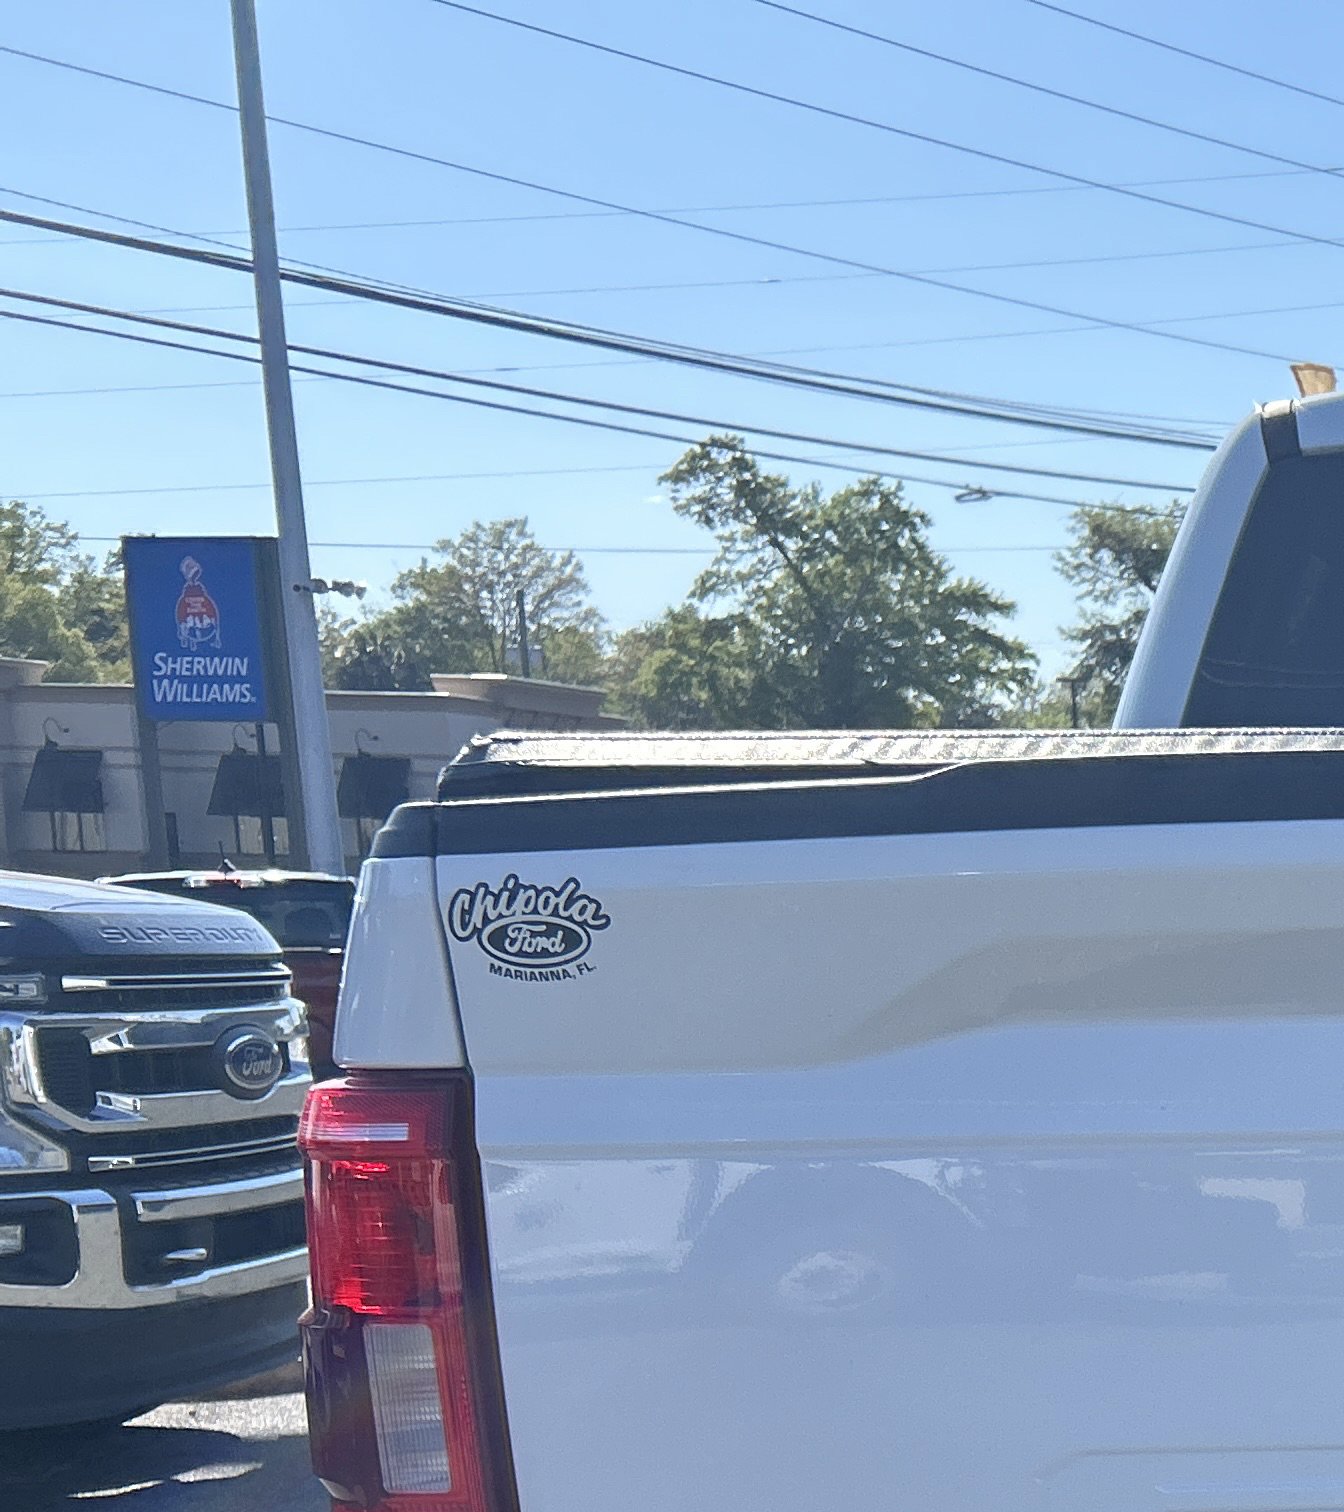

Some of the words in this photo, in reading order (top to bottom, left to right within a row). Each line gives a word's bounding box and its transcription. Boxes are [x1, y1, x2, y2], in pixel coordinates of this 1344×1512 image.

[152, 652, 249, 676] SHERWIN
[152, 679, 252, 702] WILLIAMS
[450, 874, 611, 942] Chipola
[504, 924, 565, 953] Ford
[489, 963, 576, 982] MARIANNA,
[242, 1046, 272, 1076] Ford
